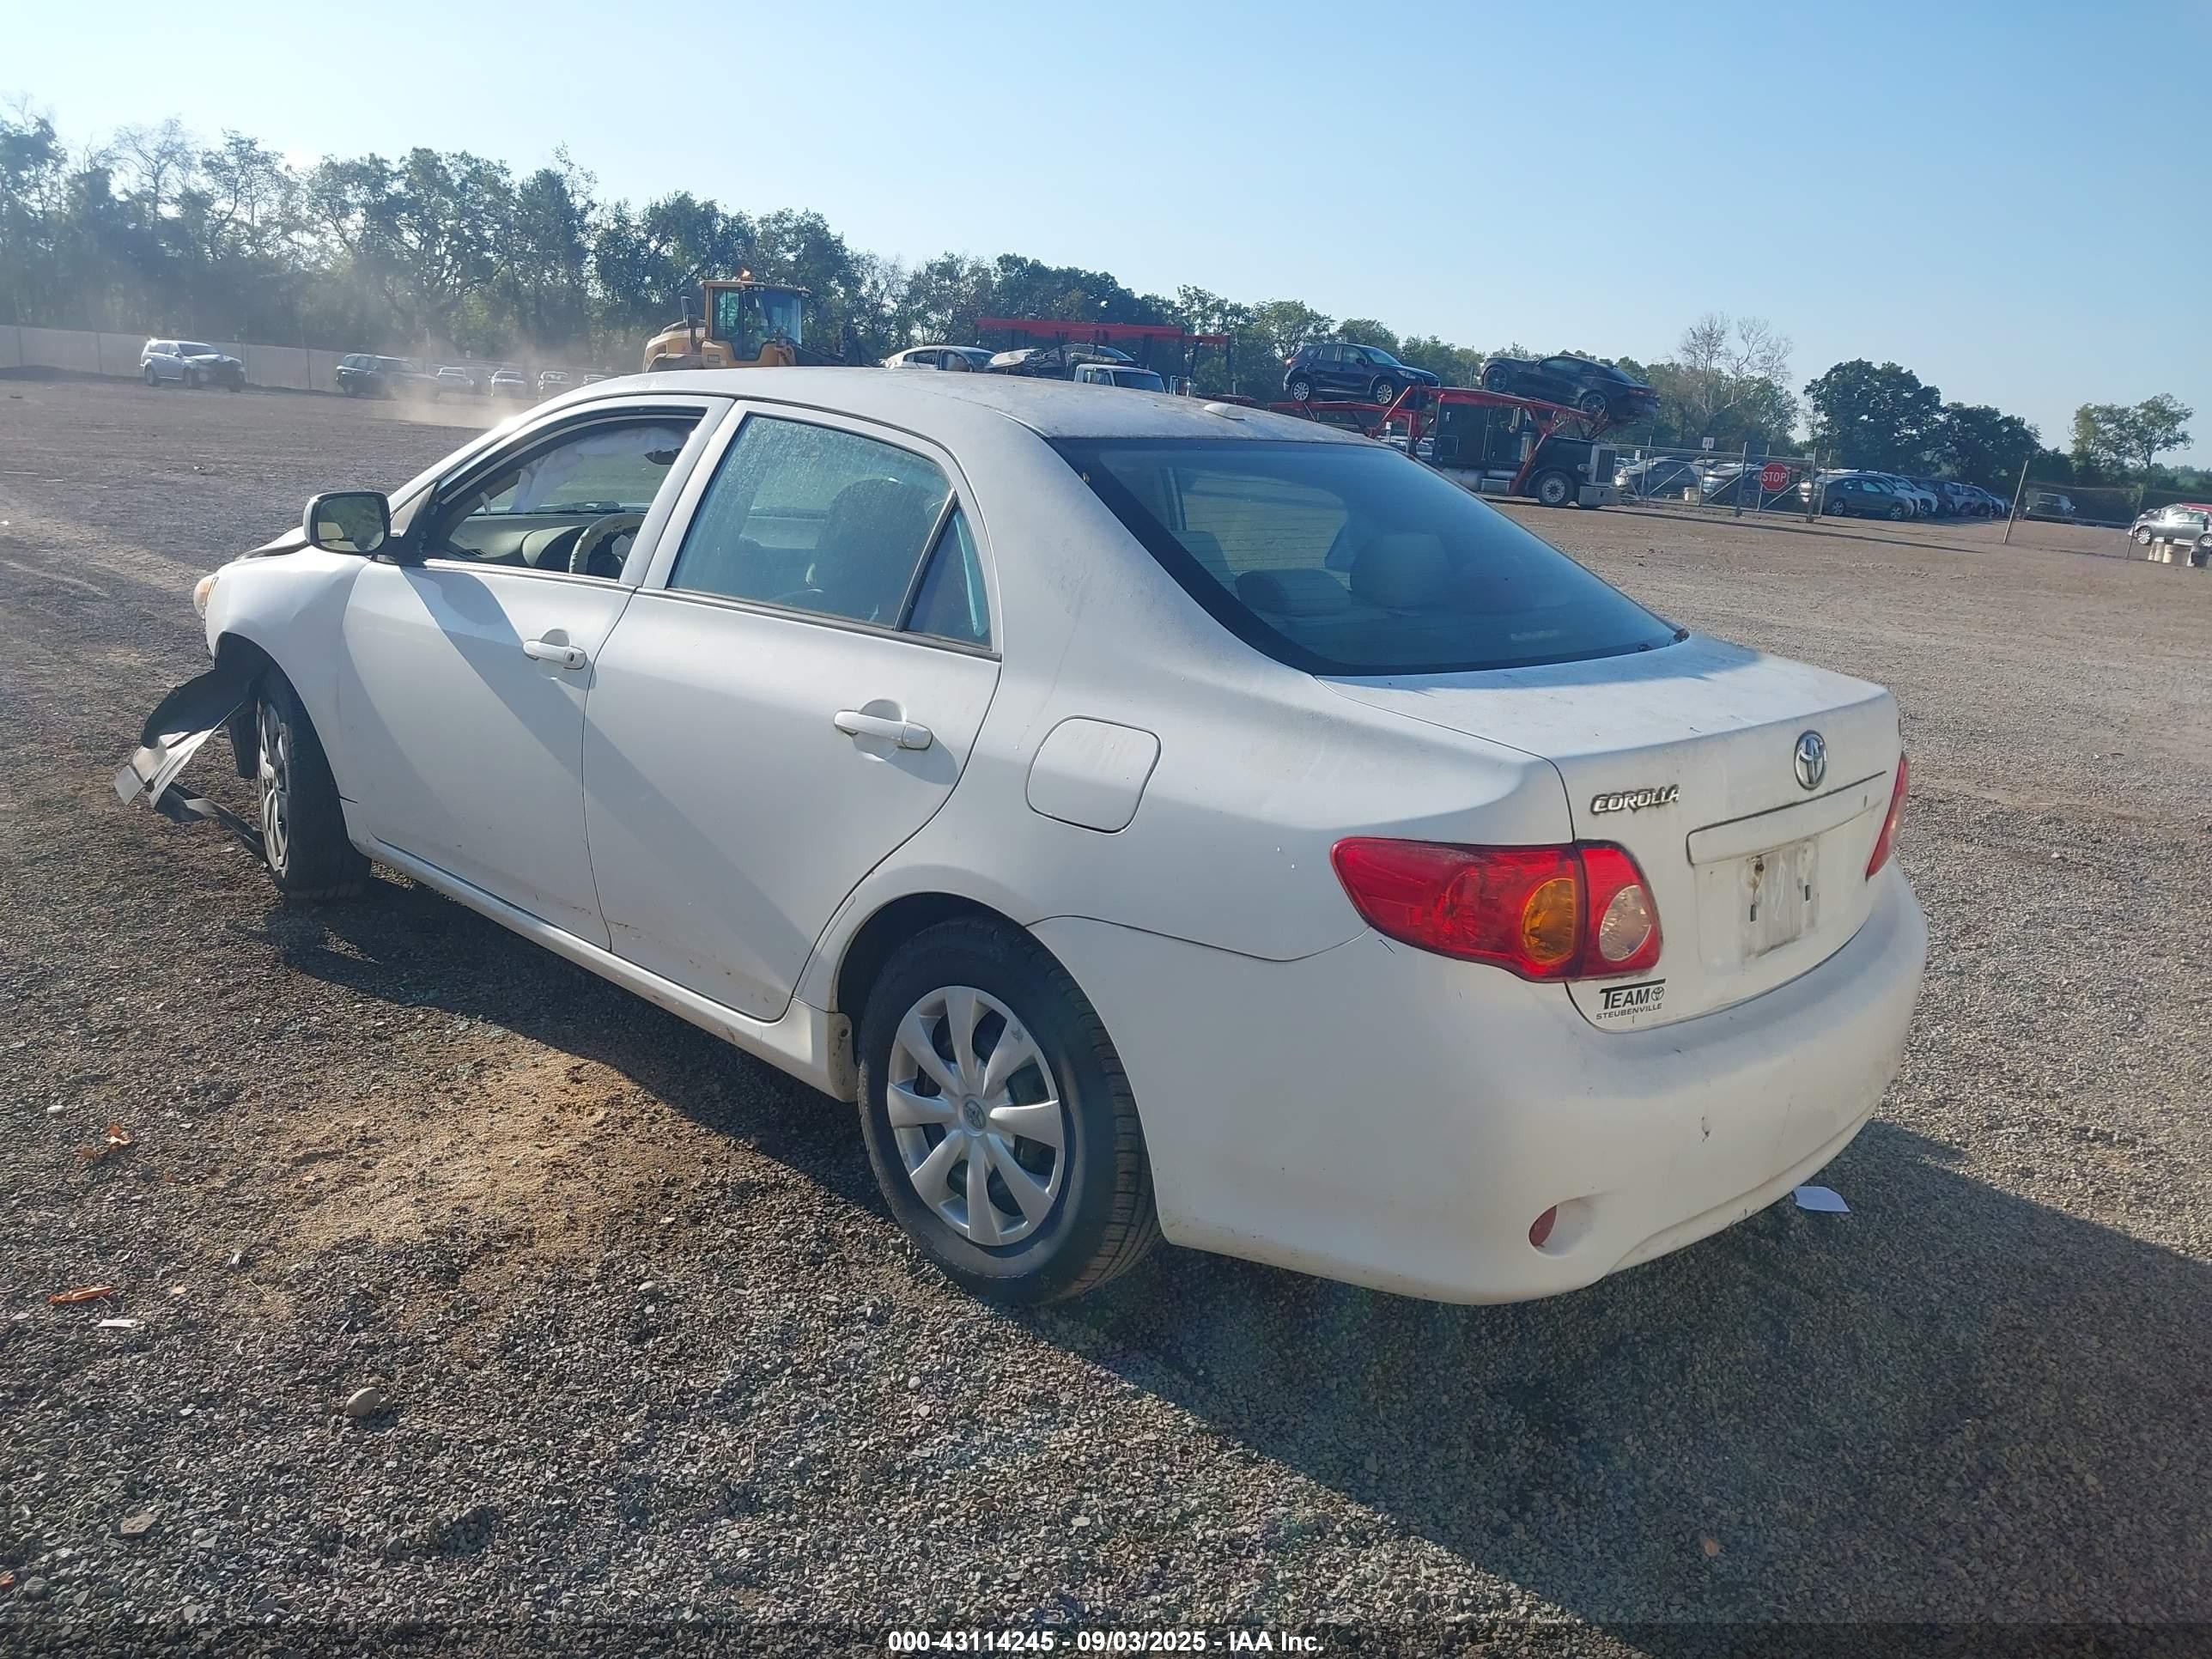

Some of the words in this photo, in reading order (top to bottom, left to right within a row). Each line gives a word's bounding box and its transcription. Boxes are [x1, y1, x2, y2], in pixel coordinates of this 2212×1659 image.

[1762, 472, 1787, 482] STOP
[1591, 785, 1680, 814] COROLLA
[1599, 978, 1666, 1010] TEAM
[1595, 1003, 1662, 1020] STEUBENVILLE
